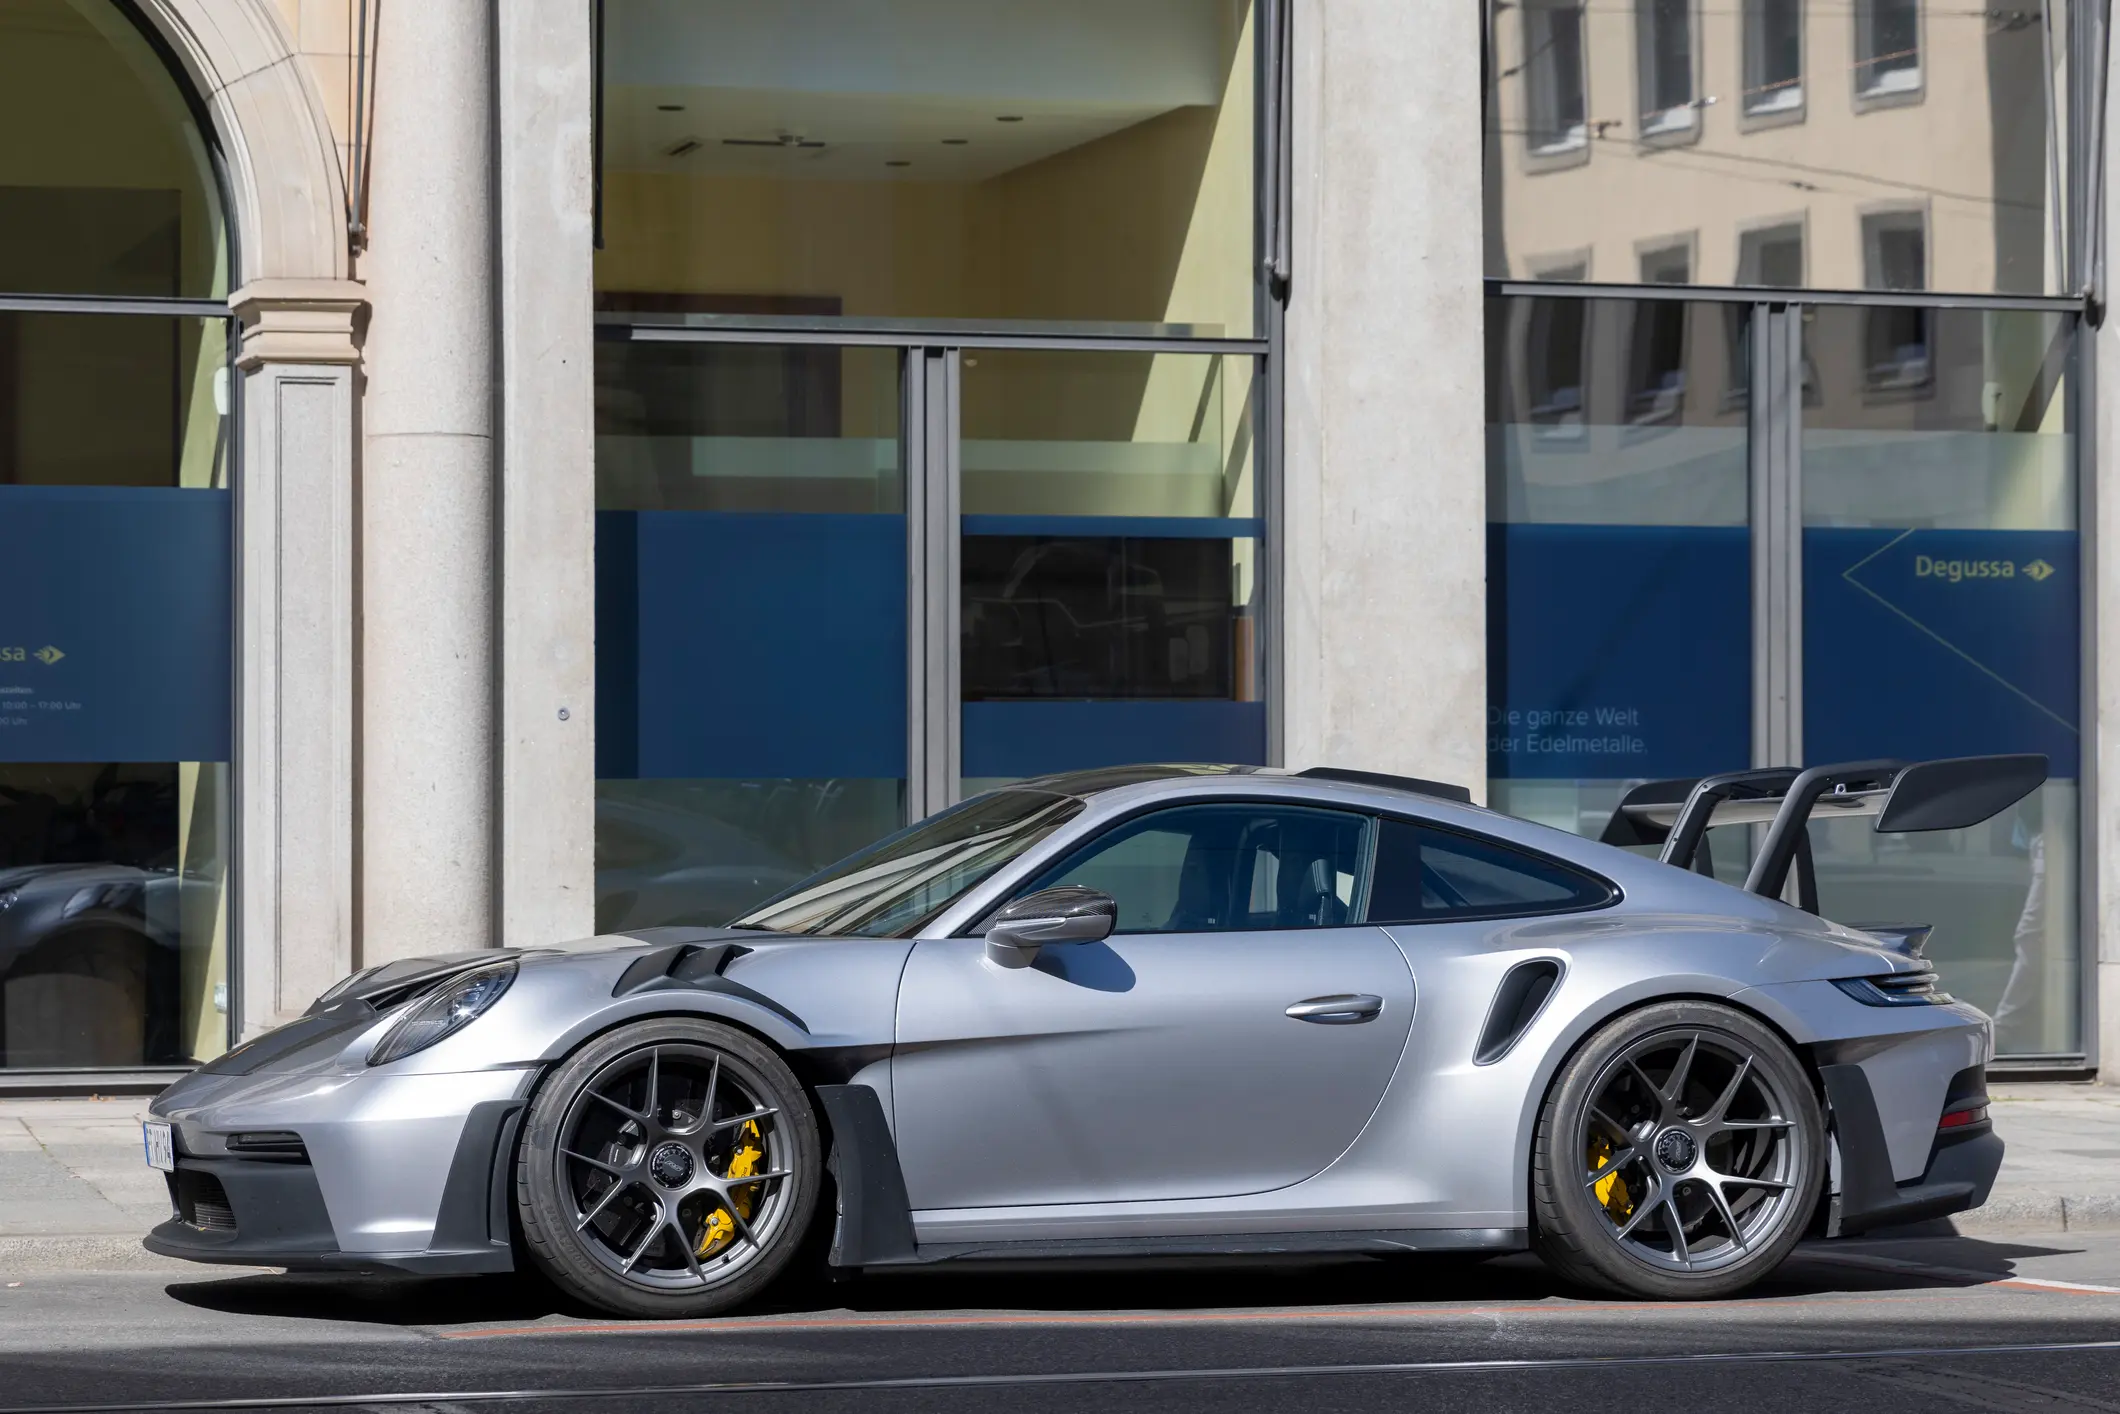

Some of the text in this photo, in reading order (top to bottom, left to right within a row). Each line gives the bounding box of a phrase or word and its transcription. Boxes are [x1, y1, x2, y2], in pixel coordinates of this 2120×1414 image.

[1916, 555, 2015, 583] Degussa
[0, 646, 25, 661] sa
[1488, 706, 1640, 730] Die ganze Welt
[1488, 734, 1520, 753] der
